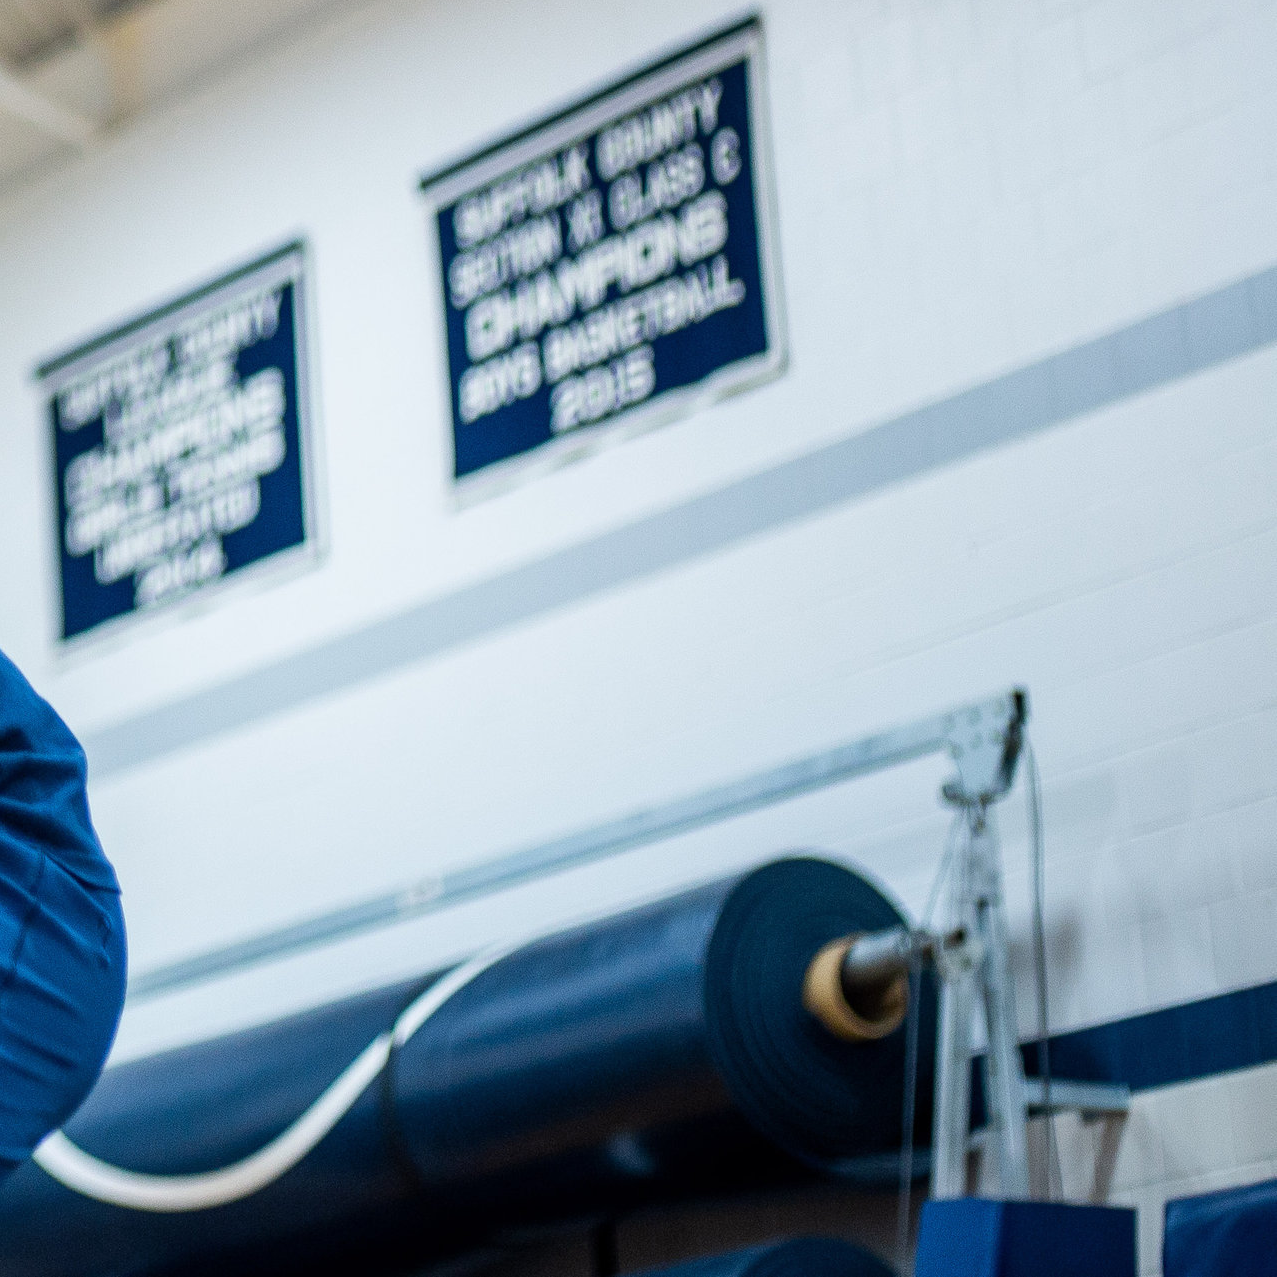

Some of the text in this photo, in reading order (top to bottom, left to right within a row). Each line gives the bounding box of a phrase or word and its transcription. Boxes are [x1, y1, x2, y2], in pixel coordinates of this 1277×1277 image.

[449, 211, 562, 309] SECTION
[608, 143, 705, 233] CLASS
[455, 78, 723, 249] SUFFOLK COUNTY
[459, 254, 746, 425] BOYS BASKETBALL
[465, 189, 729, 362] CHAMPIONS
[64, 367, 286, 509] CHAMPIONS
[551, 345, 656, 435] 2015
